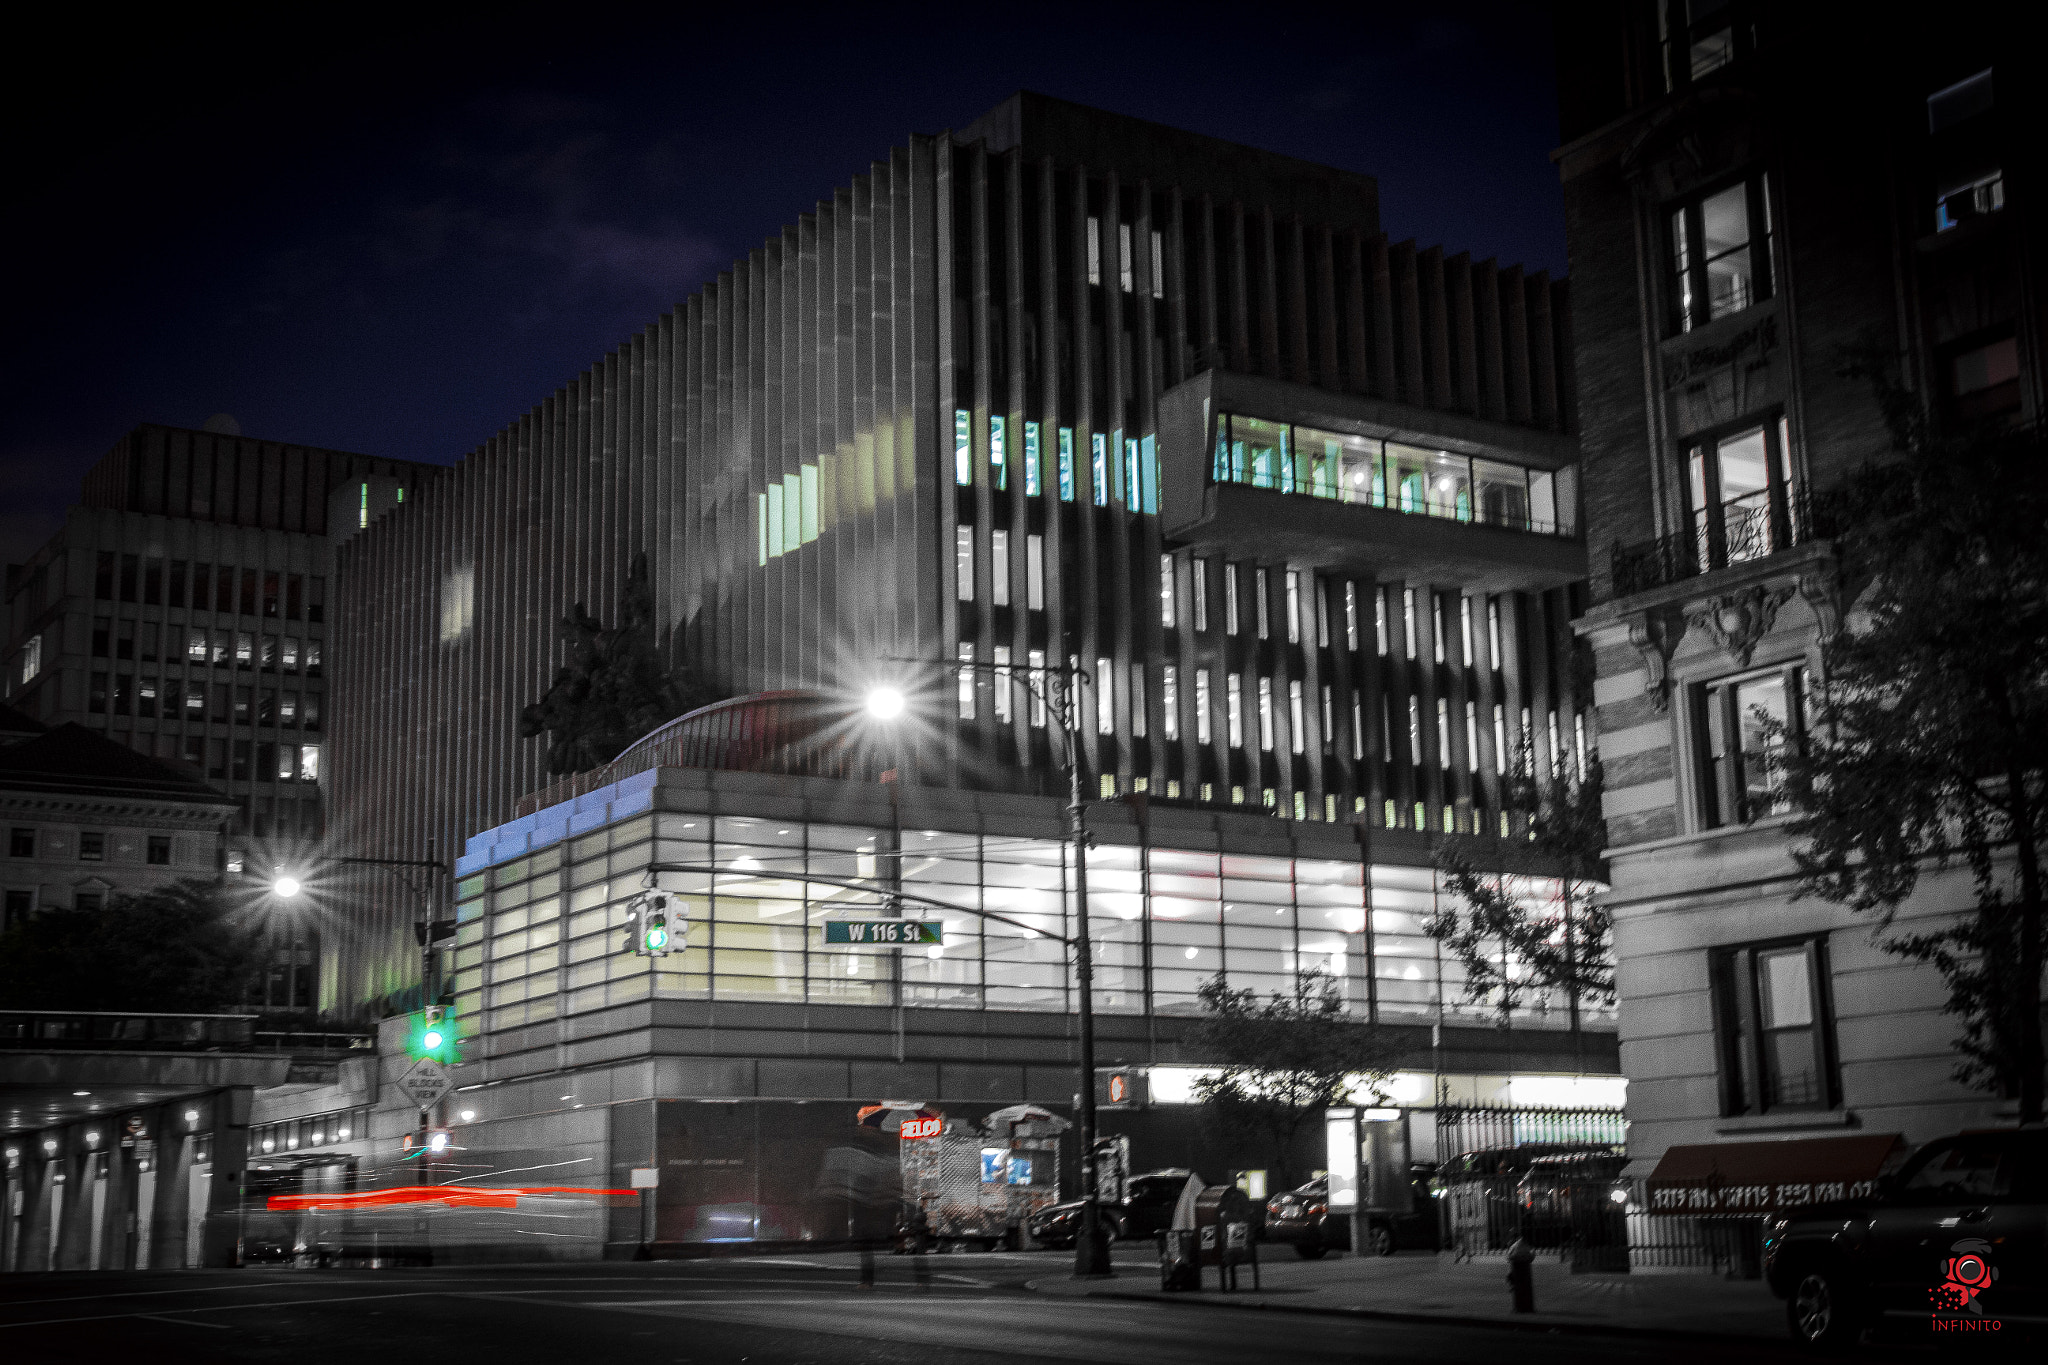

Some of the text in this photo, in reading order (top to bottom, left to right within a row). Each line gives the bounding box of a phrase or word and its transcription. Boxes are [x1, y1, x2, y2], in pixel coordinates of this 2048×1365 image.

[848, 923, 921, 941] W 116 St
